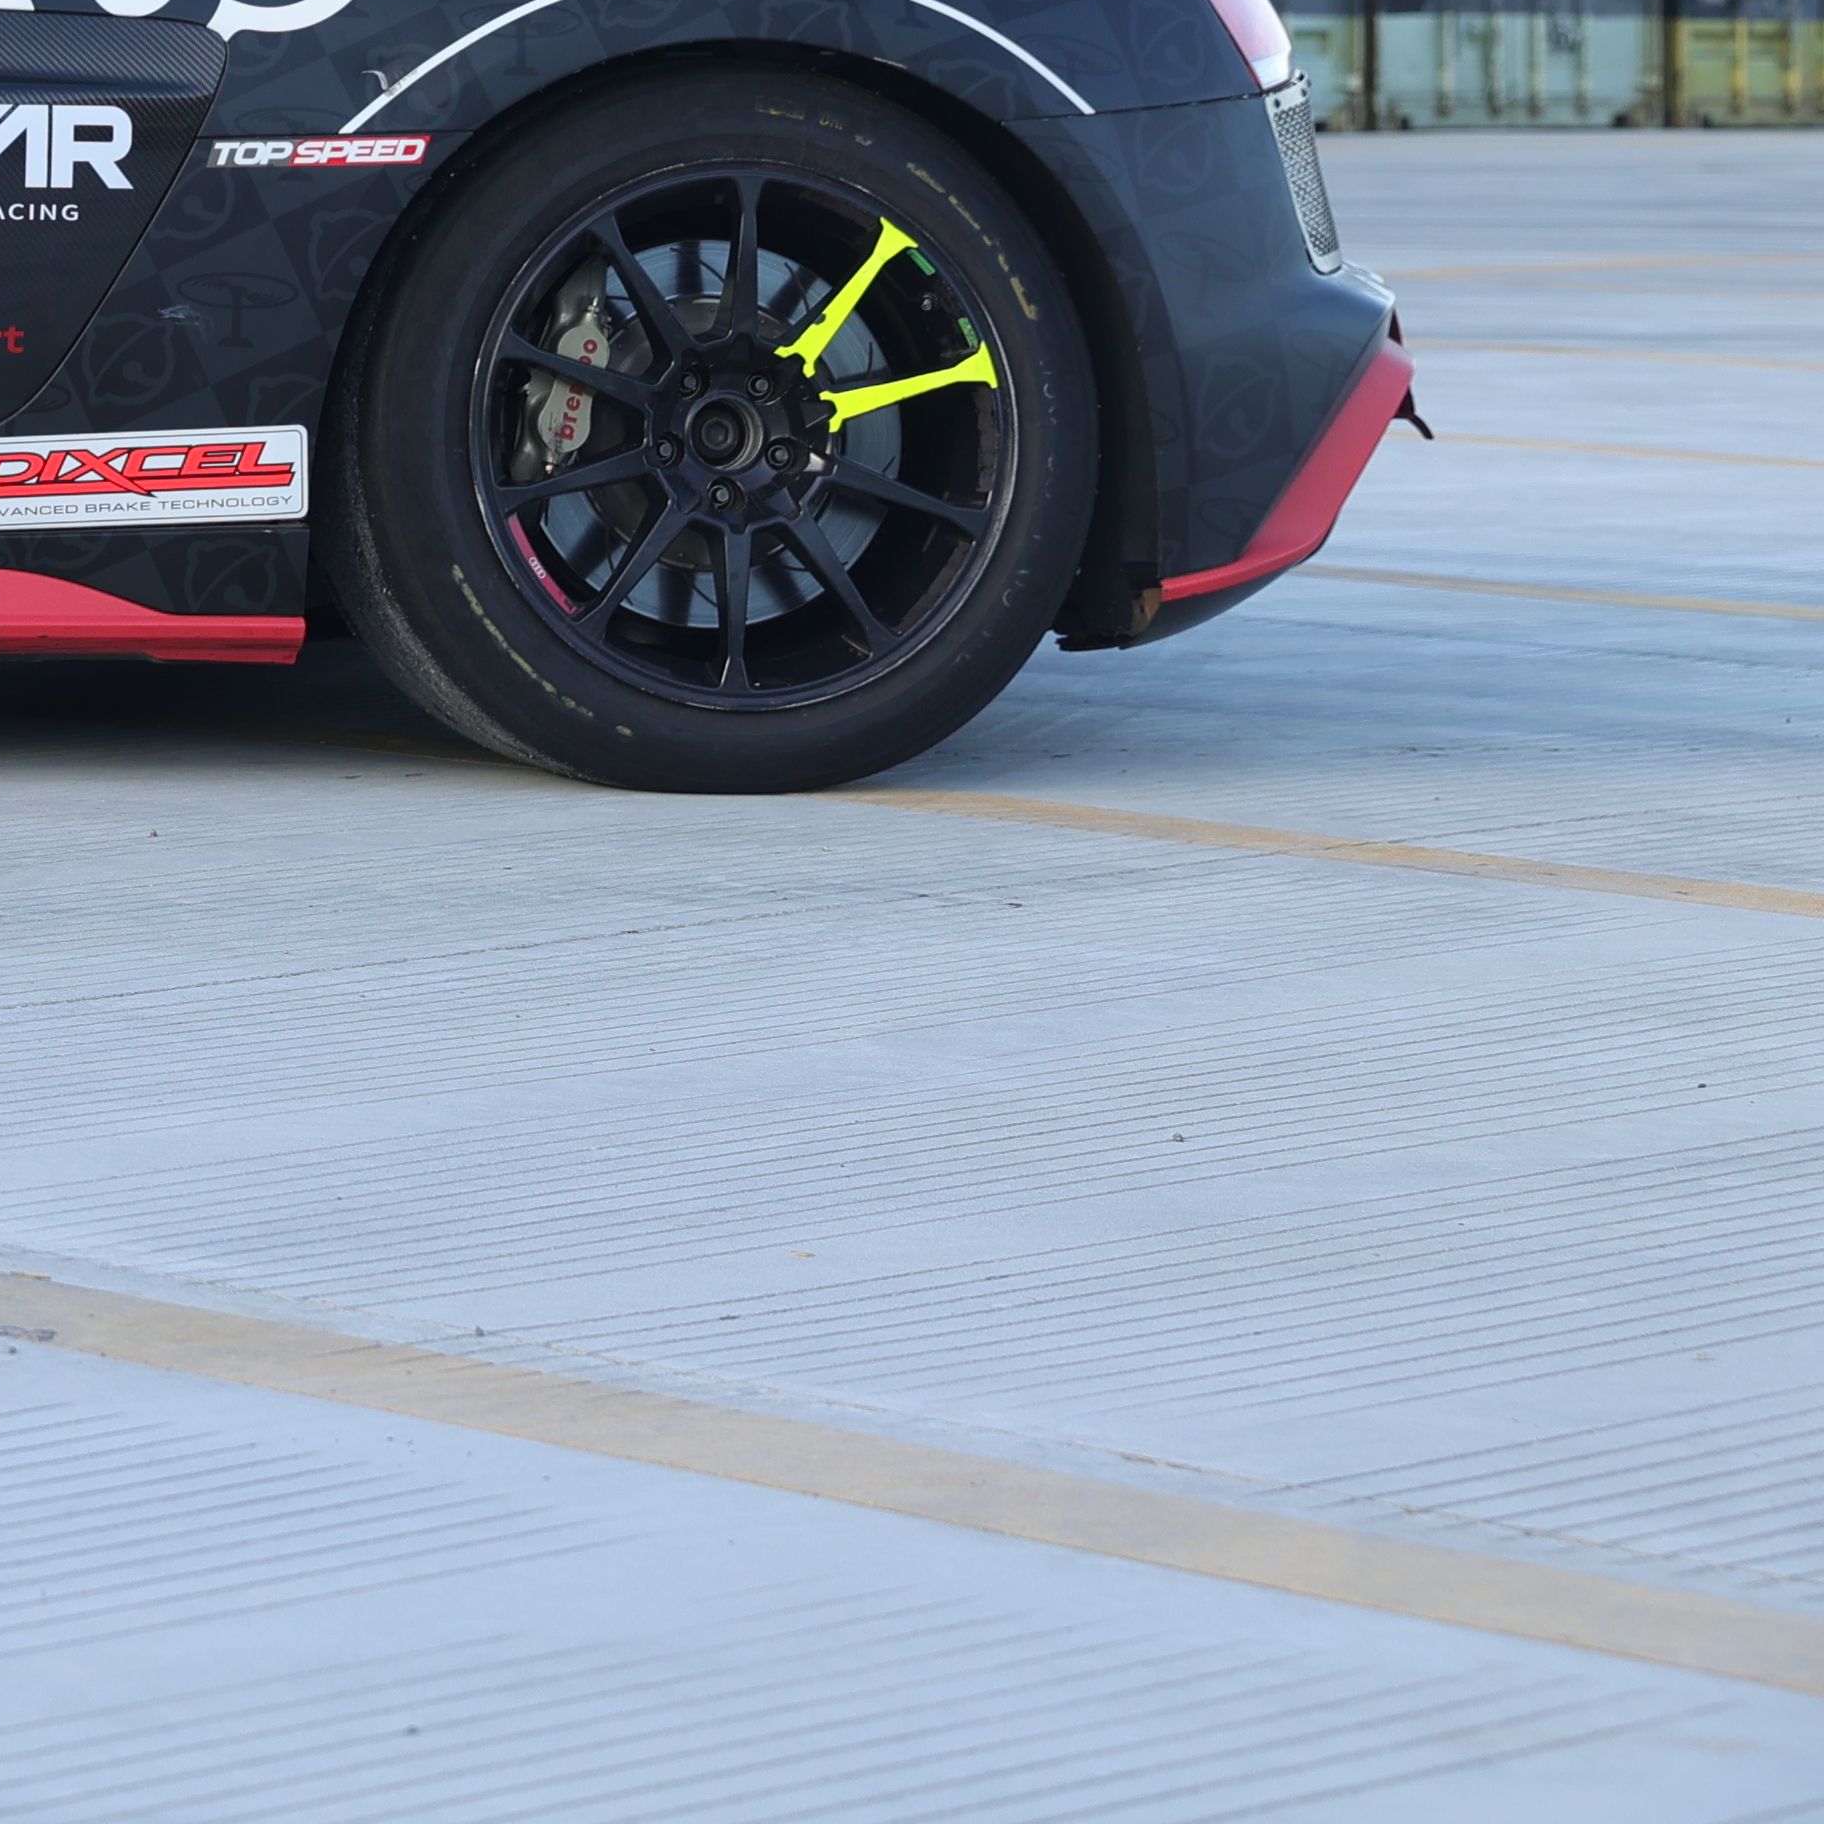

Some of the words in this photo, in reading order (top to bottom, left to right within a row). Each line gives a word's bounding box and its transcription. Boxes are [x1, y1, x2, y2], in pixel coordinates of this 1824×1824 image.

[214, 141, 294, 165] TOP
[294, 138, 425, 164] SPEED
[85, 501, 151, 514] BRAKE
[158, 495, 294, 511] TECHNOLOGY
